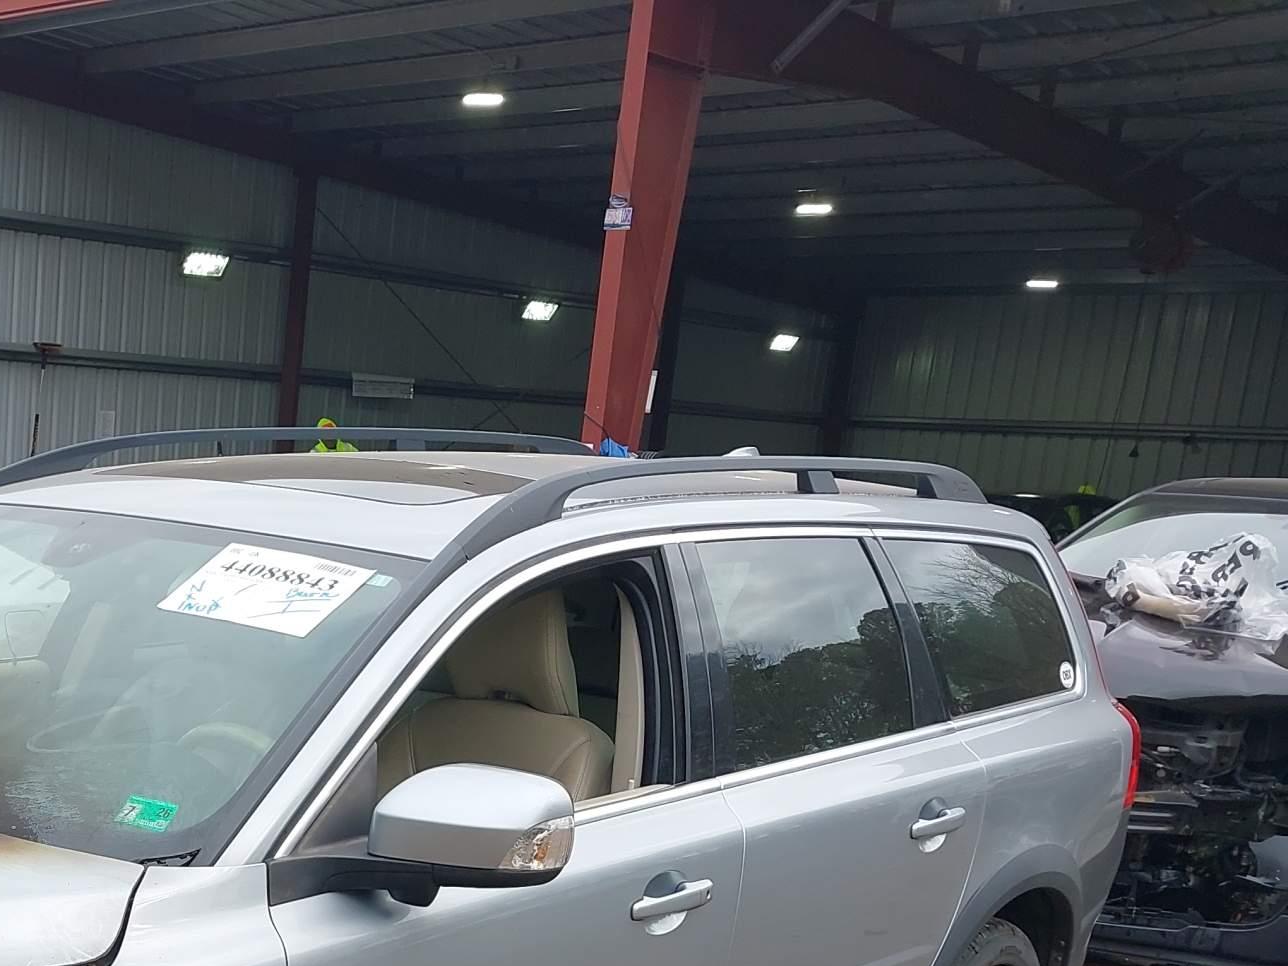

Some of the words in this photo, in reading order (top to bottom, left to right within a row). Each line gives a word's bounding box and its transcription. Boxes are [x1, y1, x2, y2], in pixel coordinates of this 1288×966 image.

[221, 560, 339, 591] 44088843
[124, 805, 136, 817] 7
[156, 808, 172, 819] 26
